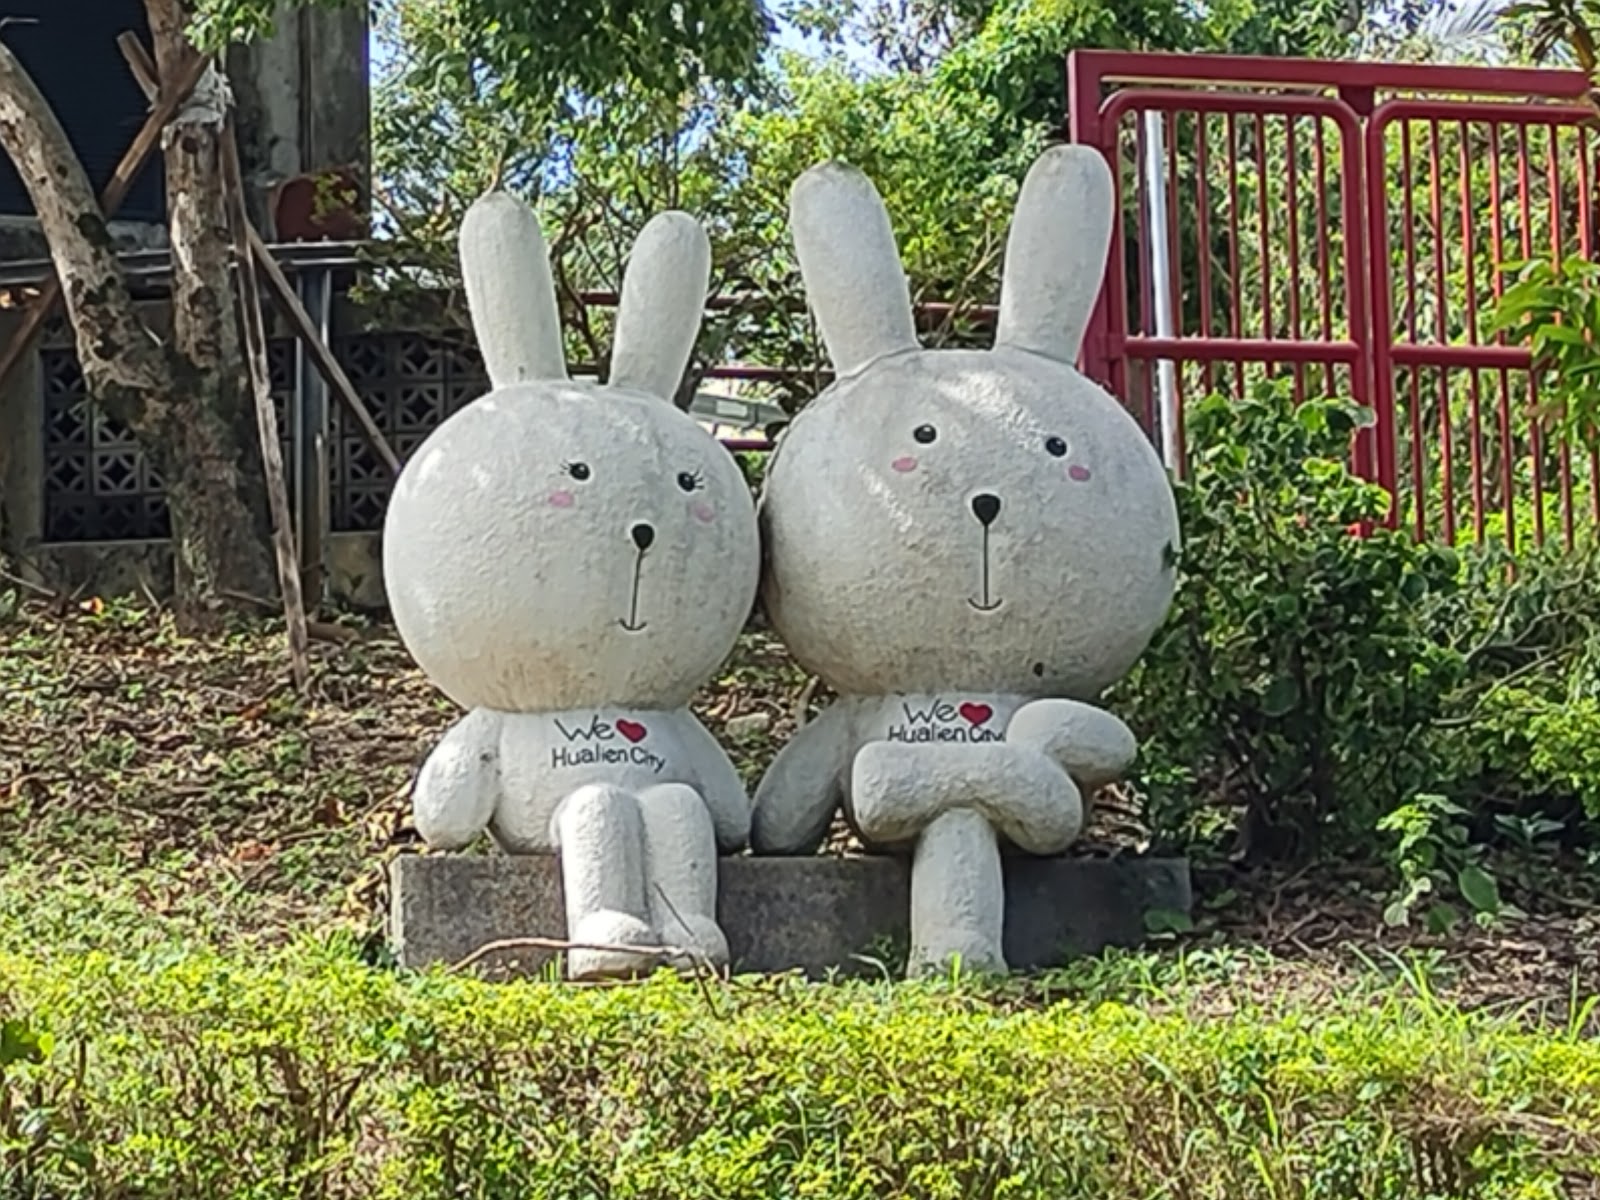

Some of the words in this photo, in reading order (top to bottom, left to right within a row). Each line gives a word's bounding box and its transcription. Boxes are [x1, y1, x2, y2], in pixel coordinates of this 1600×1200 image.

[902, 698, 959, 723] We
[554, 714, 615, 741] We
[888, 722, 967, 743] Hualien
[552, 743, 629, 769] Hualien
[630, 746, 666, 773] City
